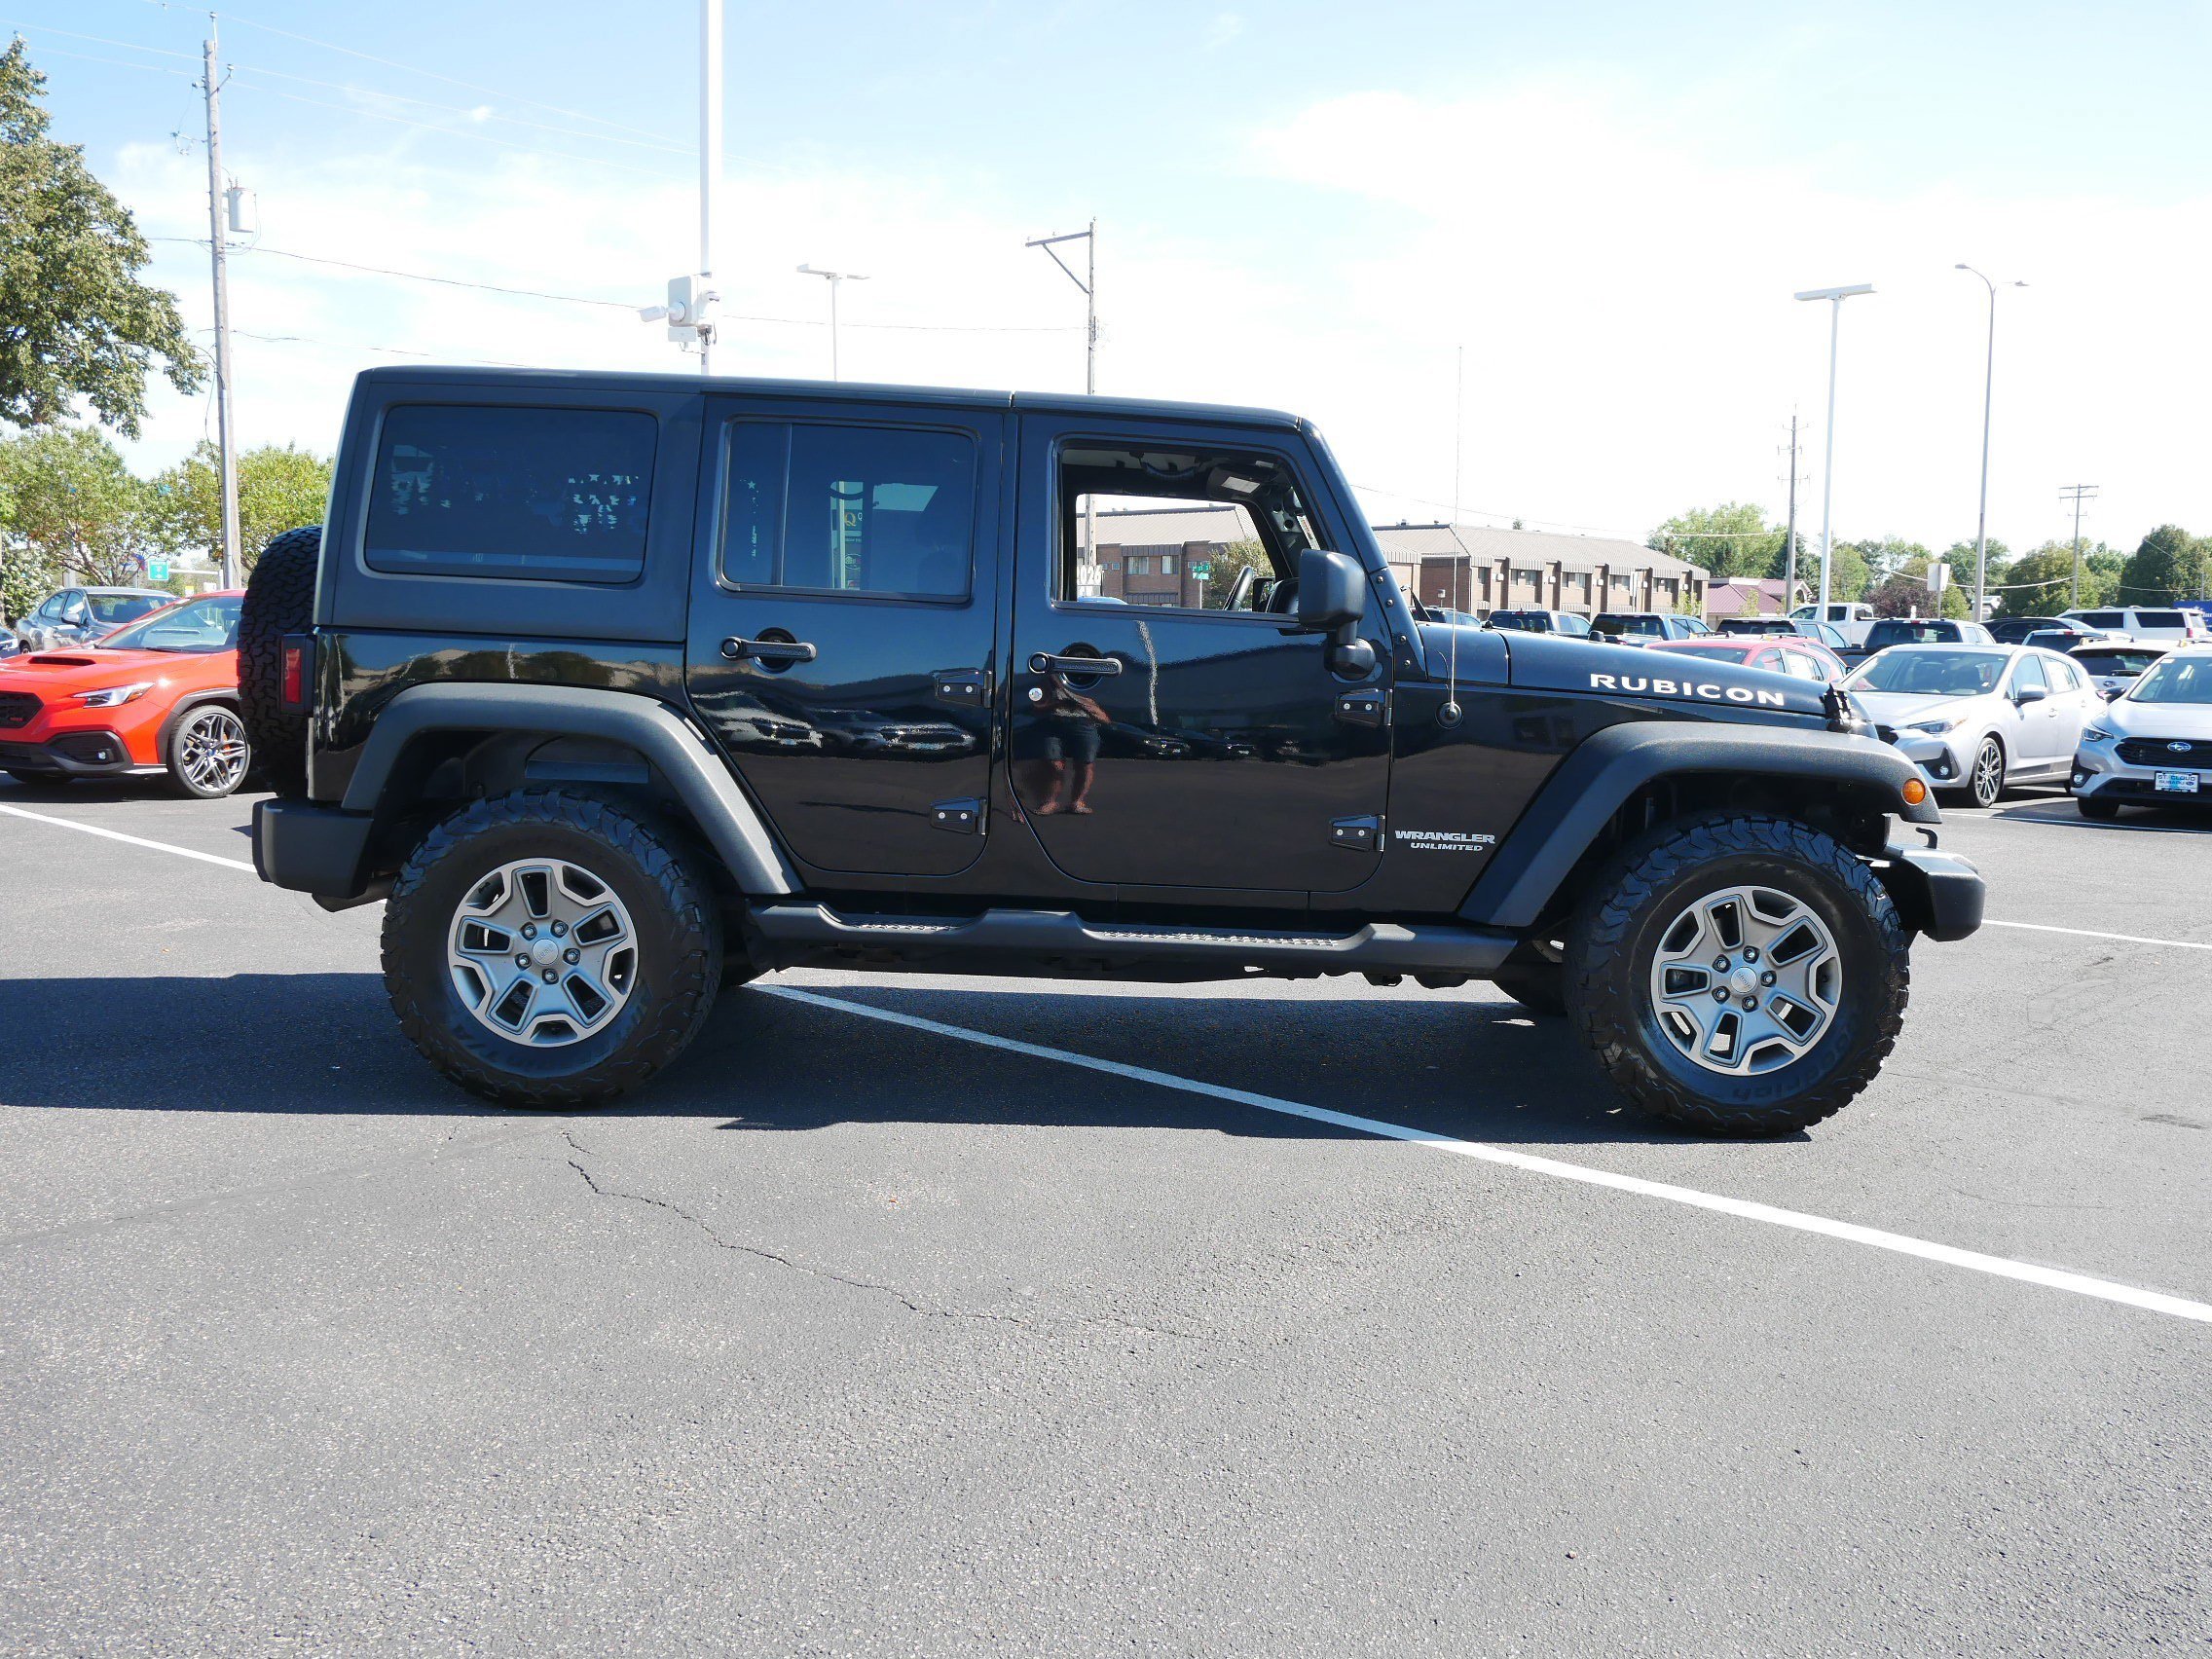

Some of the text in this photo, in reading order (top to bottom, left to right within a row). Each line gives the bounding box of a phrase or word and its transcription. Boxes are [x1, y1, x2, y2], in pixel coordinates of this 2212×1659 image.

[1590, 673, 1786, 707] RUBICON
[1394, 830, 1496, 844] WRANGLER
[1410, 842, 1484, 852] UNLIMITED
